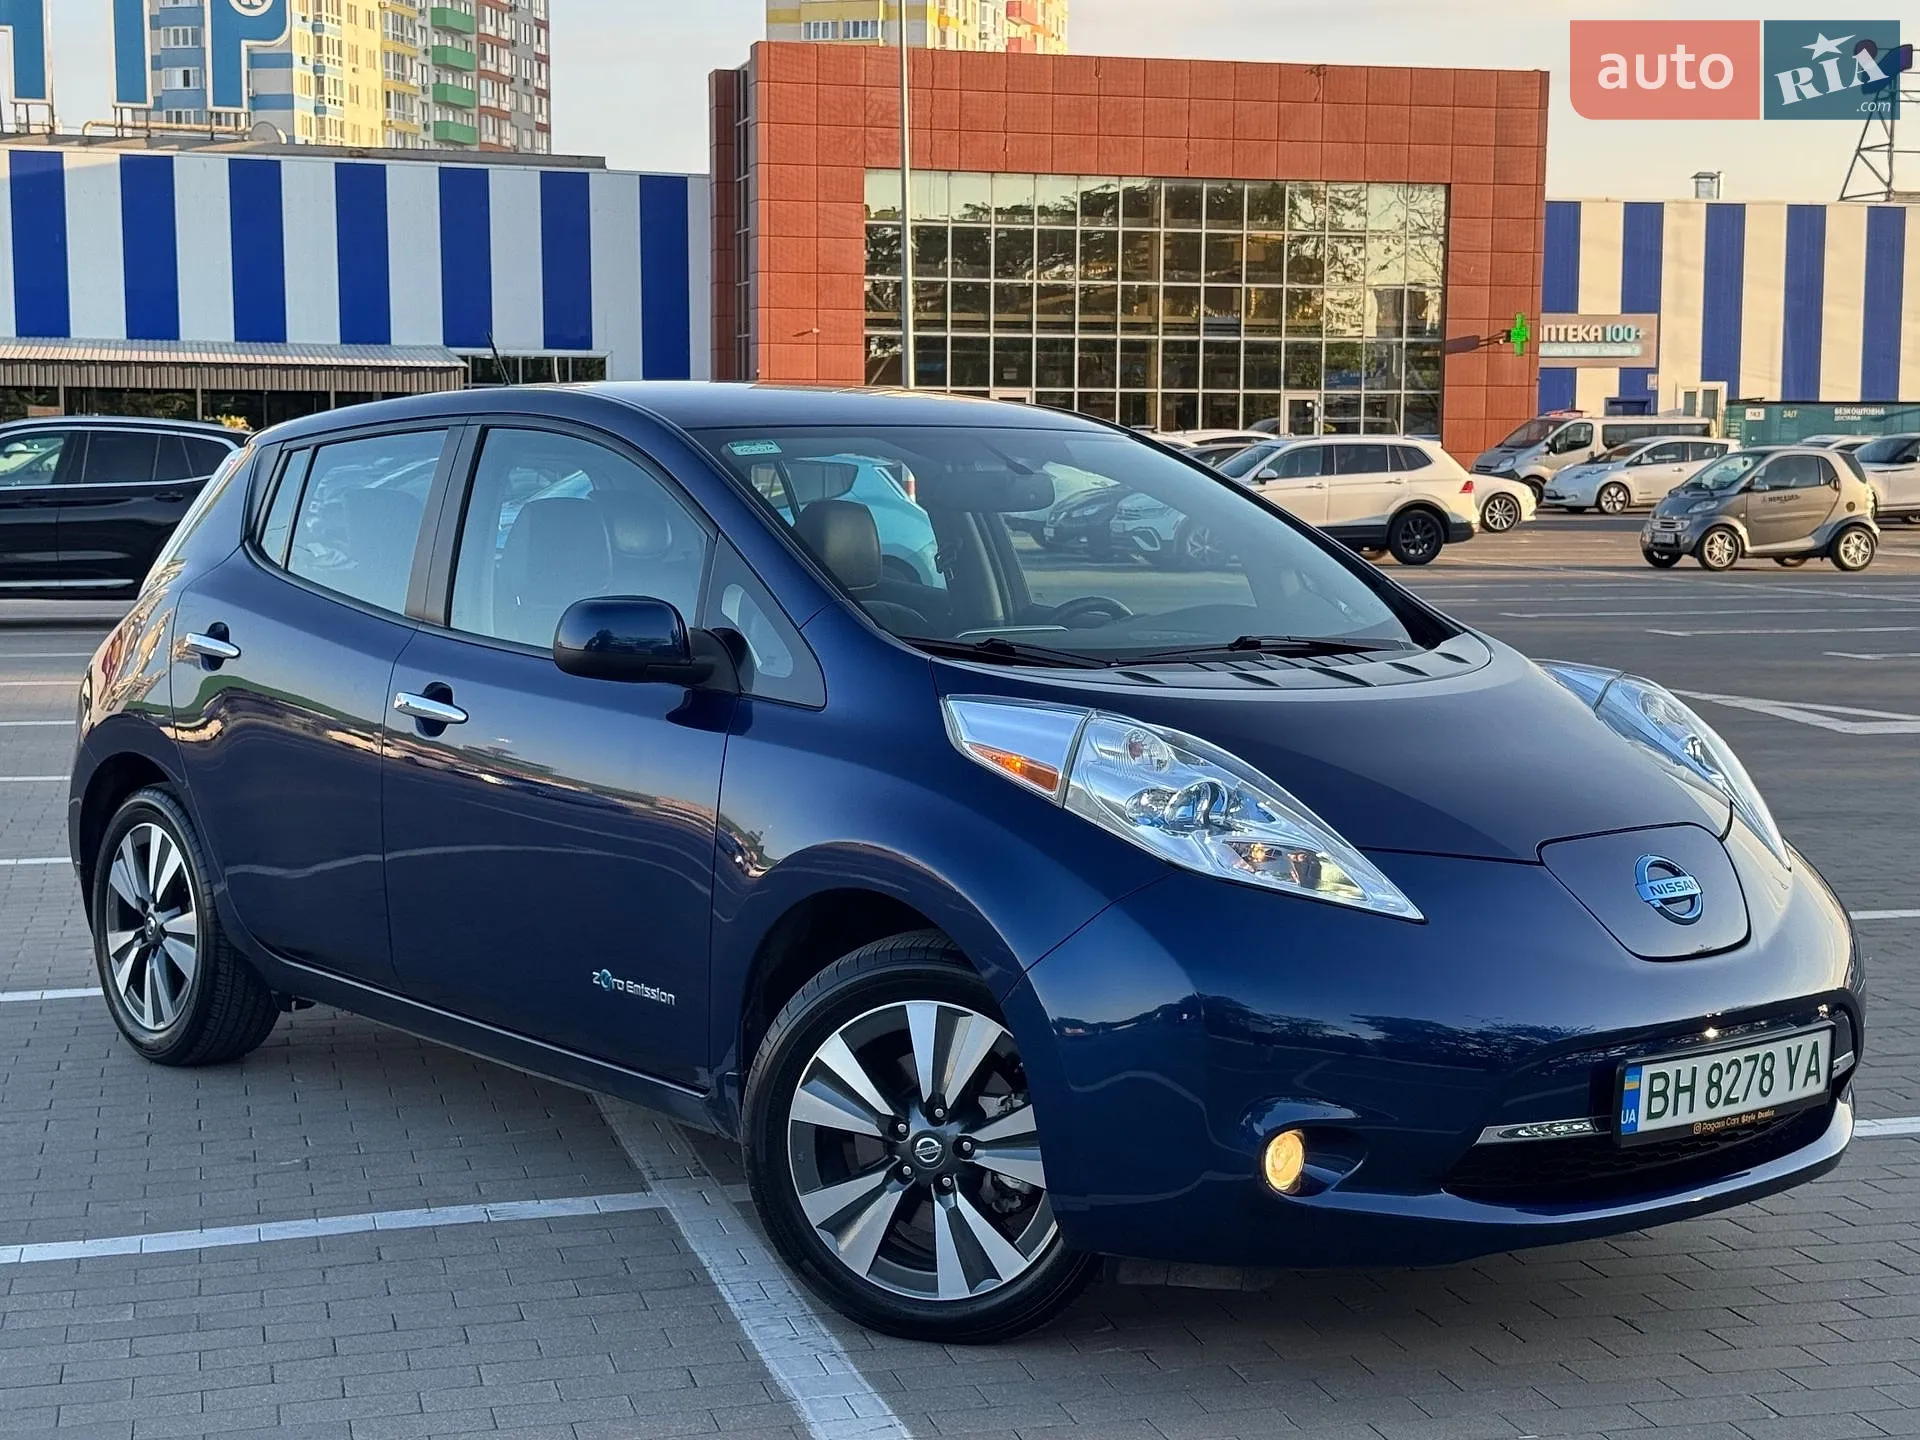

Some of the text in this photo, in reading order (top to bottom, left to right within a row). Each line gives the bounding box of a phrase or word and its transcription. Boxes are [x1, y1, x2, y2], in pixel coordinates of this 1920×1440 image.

[1540, 323, 1602, 342] ПТЕКА
[626, 980, 675, 1005] Emission
[1646, 1040, 1821, 1121] BH 8278 YA
[1621, 1109, 1636, 1125] UA
